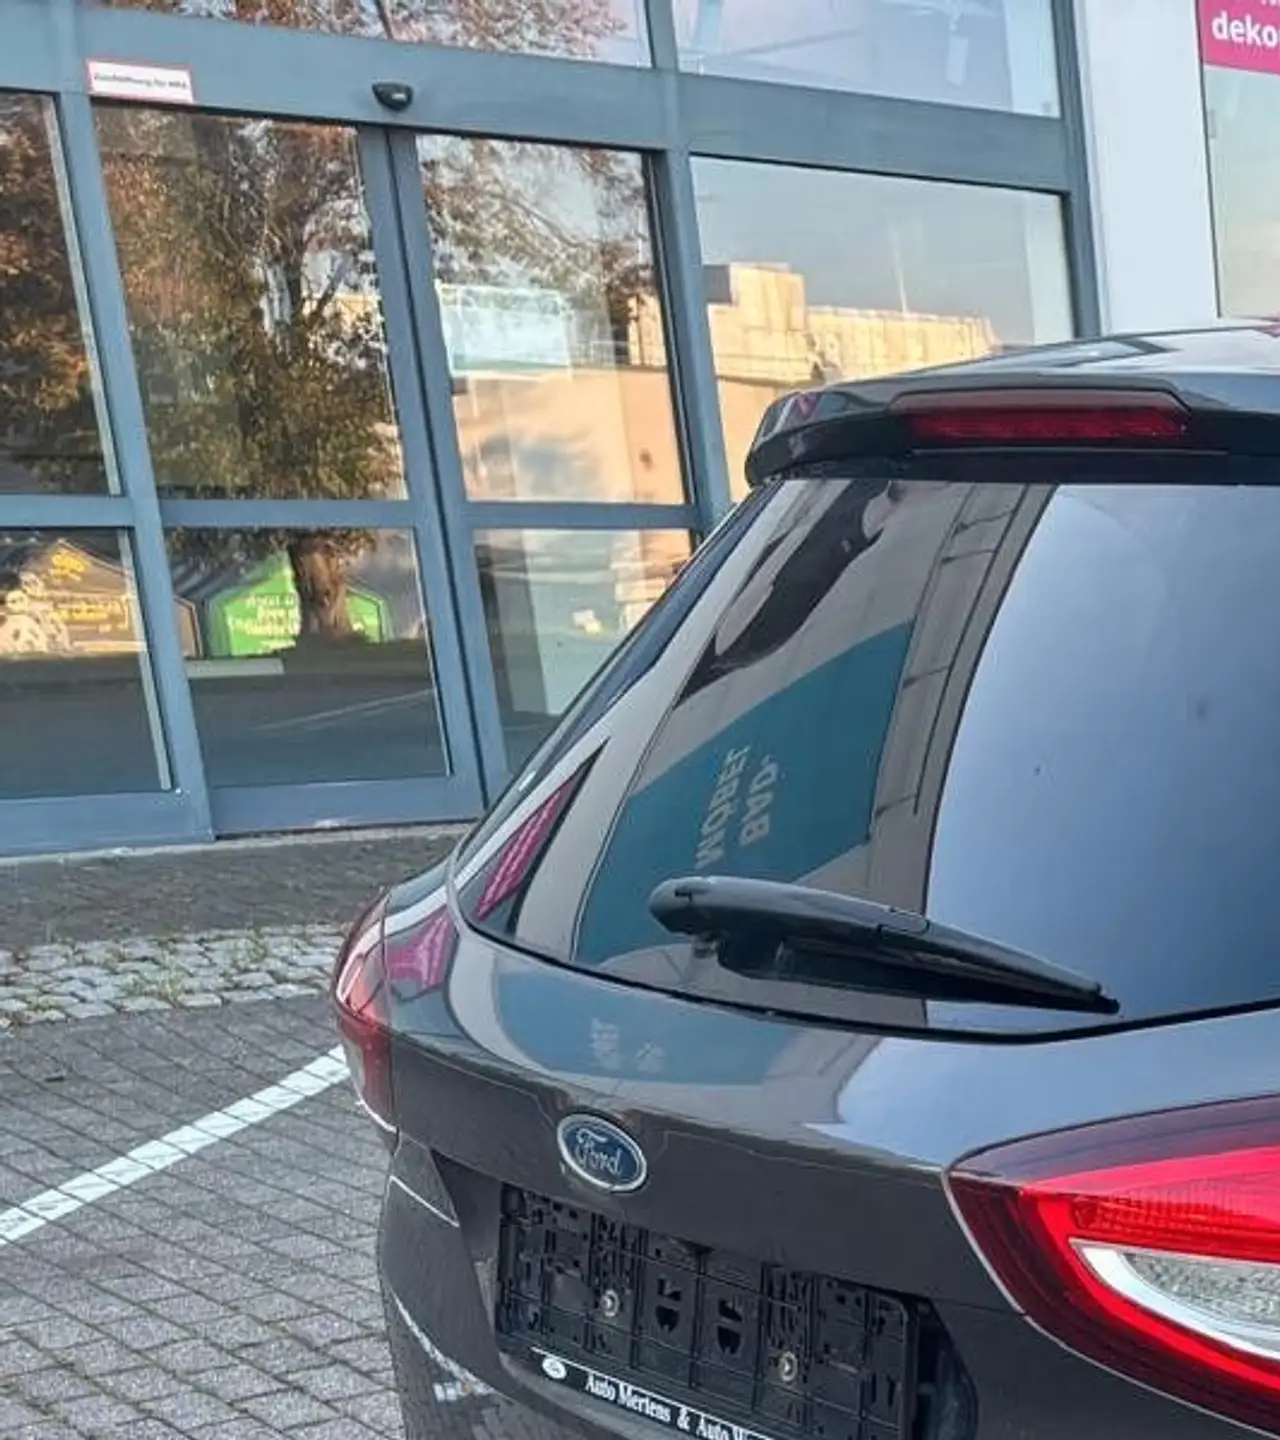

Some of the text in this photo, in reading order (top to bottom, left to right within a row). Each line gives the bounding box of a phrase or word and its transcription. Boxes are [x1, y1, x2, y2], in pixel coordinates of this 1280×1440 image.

[575, 1128, 623, 1176] Ford
[585, 1371, 616, 1401] Auto
[617, 1382, 671, 1423] Mertens
[677, 1406, 690, 1431] &
